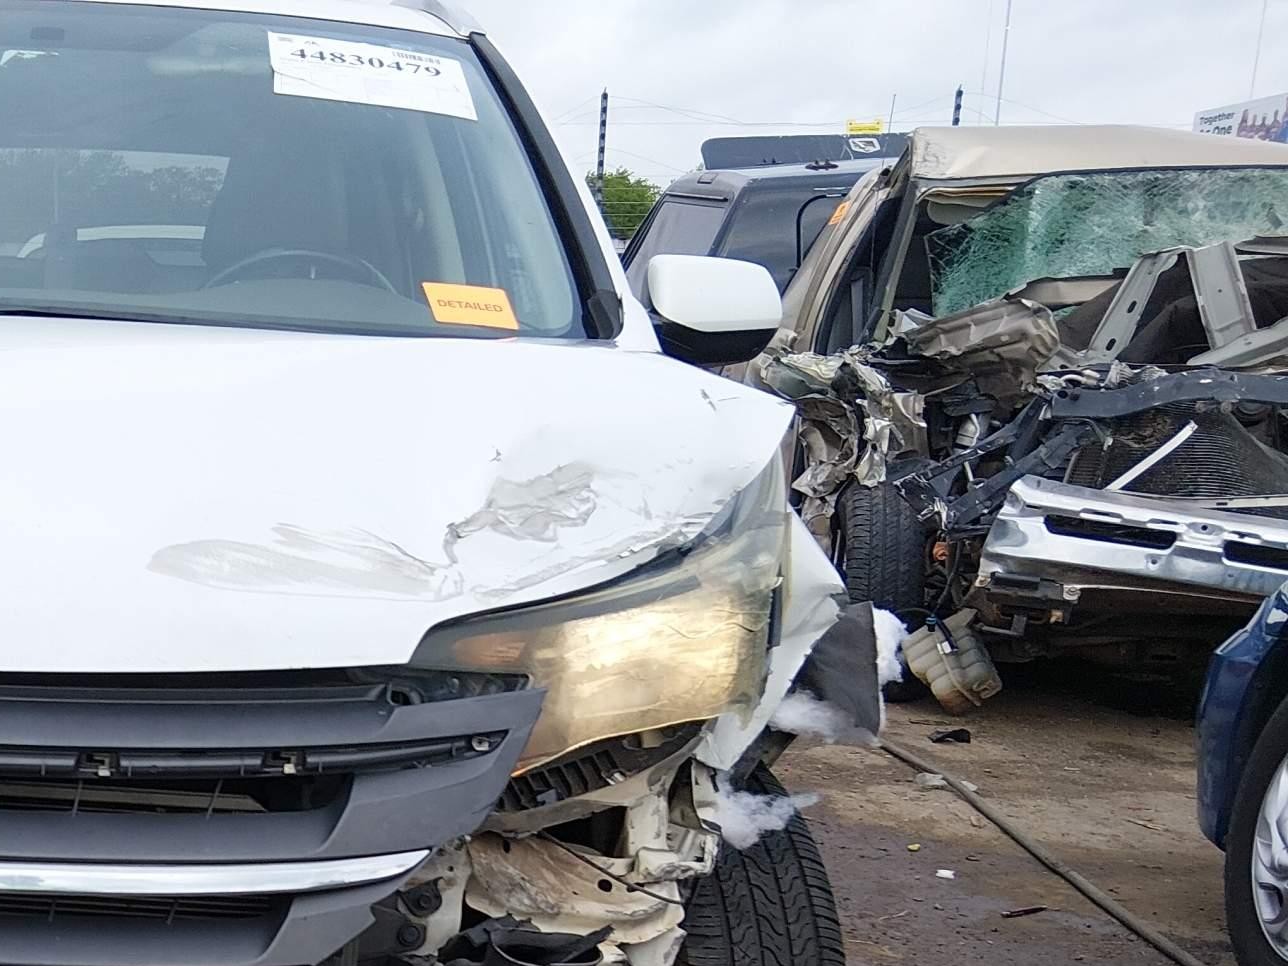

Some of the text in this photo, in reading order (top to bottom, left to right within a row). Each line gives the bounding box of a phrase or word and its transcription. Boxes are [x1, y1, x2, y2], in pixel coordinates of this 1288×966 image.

[290, 48, 442, 77] 44830479
[1199, 112, 1235, 126] Together
[436, 299, 504, 313] DETAILED
